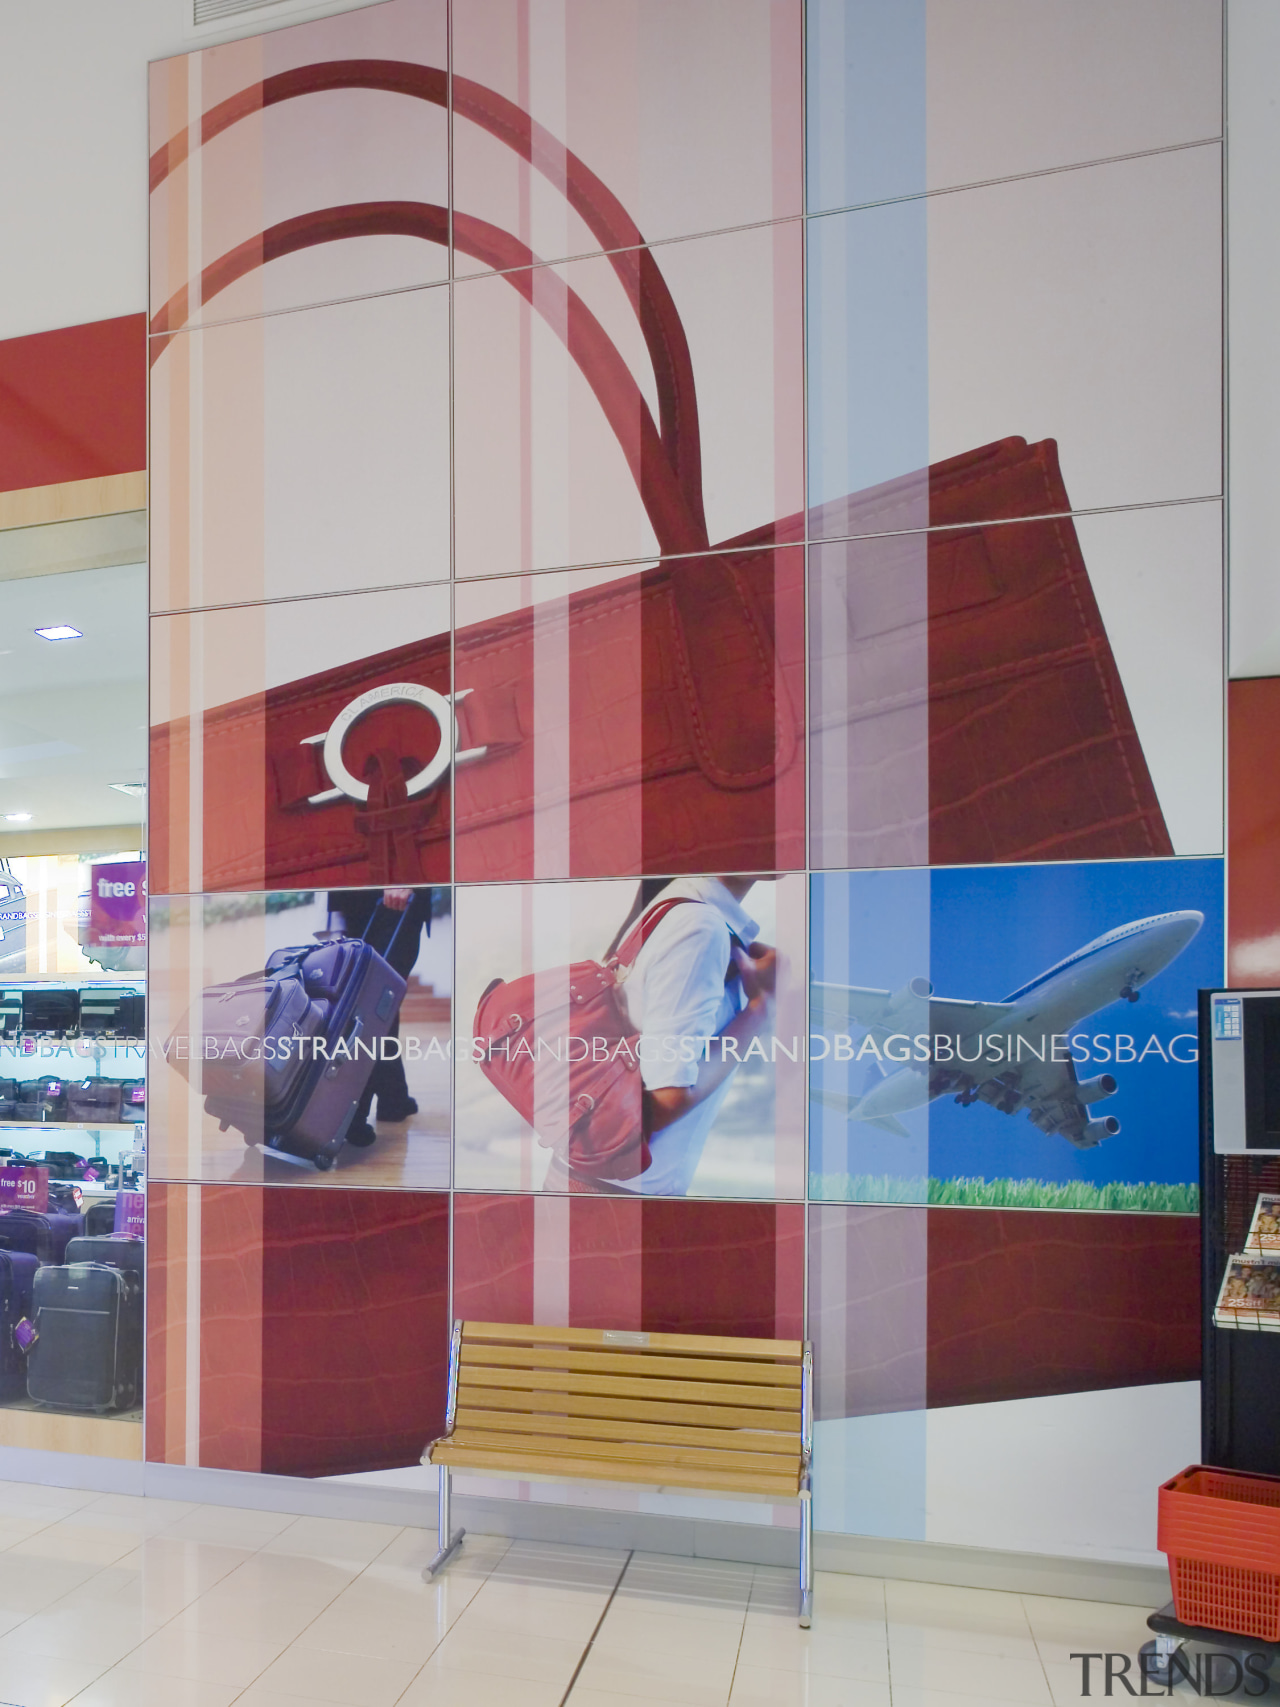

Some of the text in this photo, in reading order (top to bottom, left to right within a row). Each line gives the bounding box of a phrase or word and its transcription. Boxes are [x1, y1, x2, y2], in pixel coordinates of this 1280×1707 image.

[97, 878, 135, 898] free
[1, 1178, 36, 1194] free $10
[1228, 1298, 1245, 1308] 25
